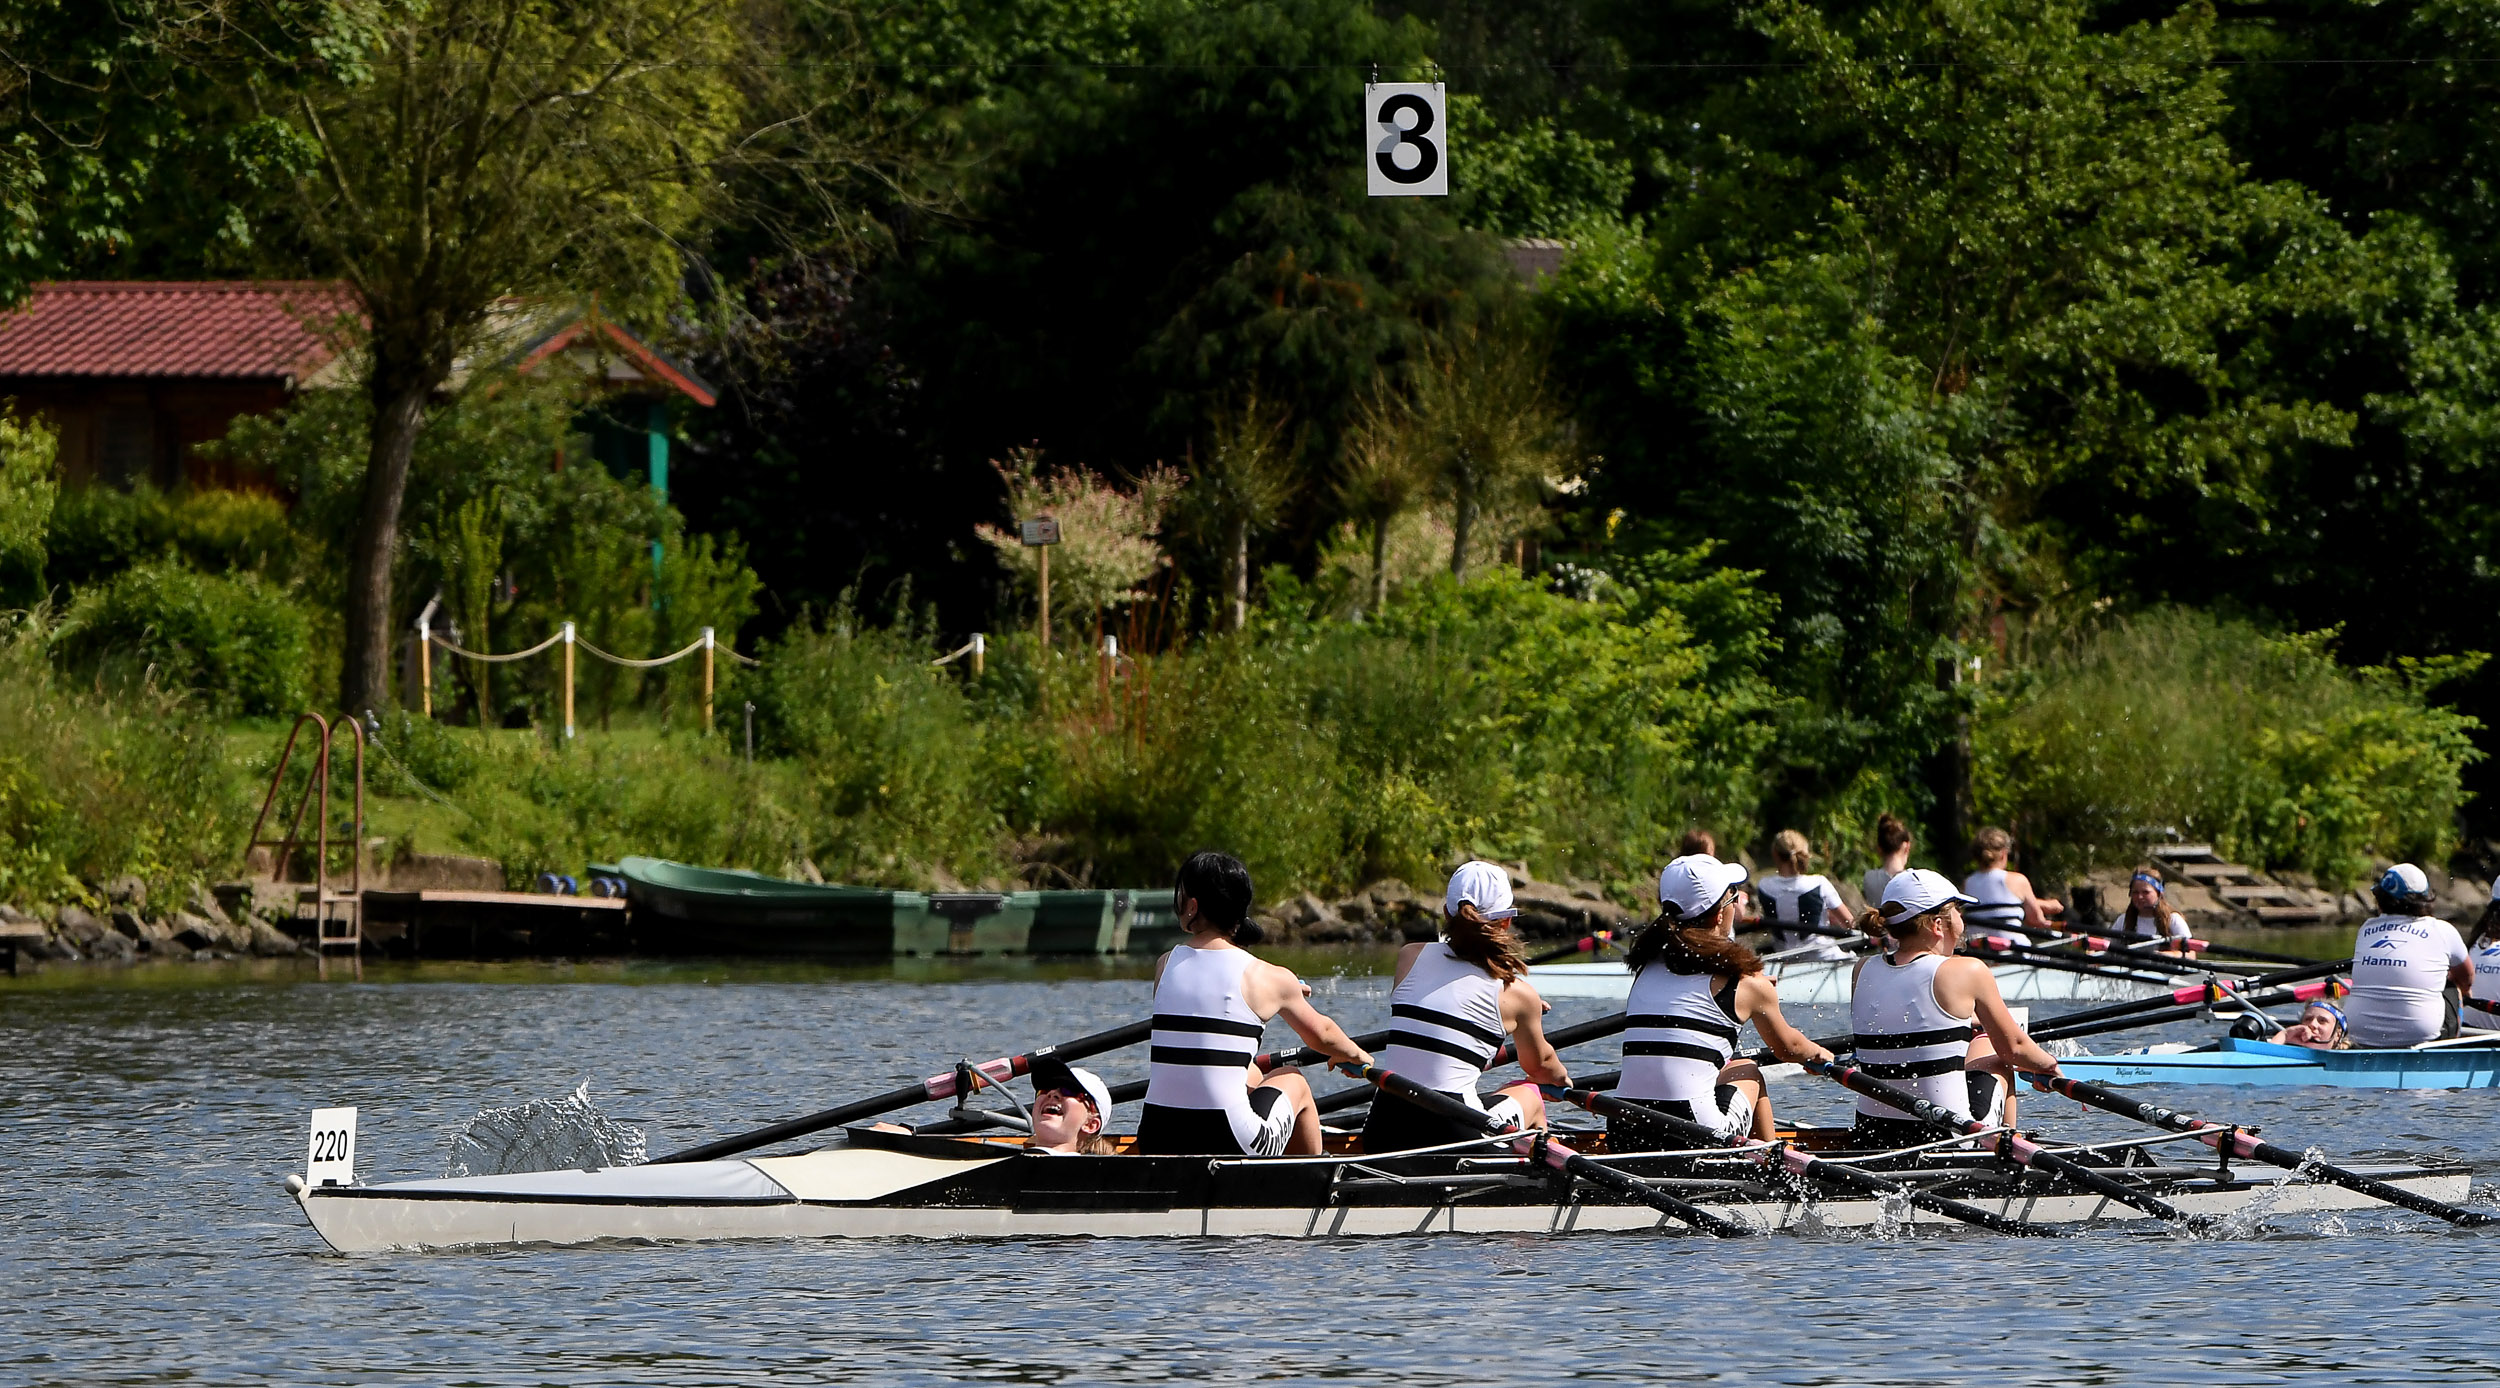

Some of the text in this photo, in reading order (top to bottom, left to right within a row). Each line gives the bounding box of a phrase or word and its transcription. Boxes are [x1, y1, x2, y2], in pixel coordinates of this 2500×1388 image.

[1377, 93, 1439, 184] 3
[2364, 922, 2429, 939] Ruderclub
[2361, 955, 2407, 967] Hamm
[313, 1129, 348, 1163] 220
